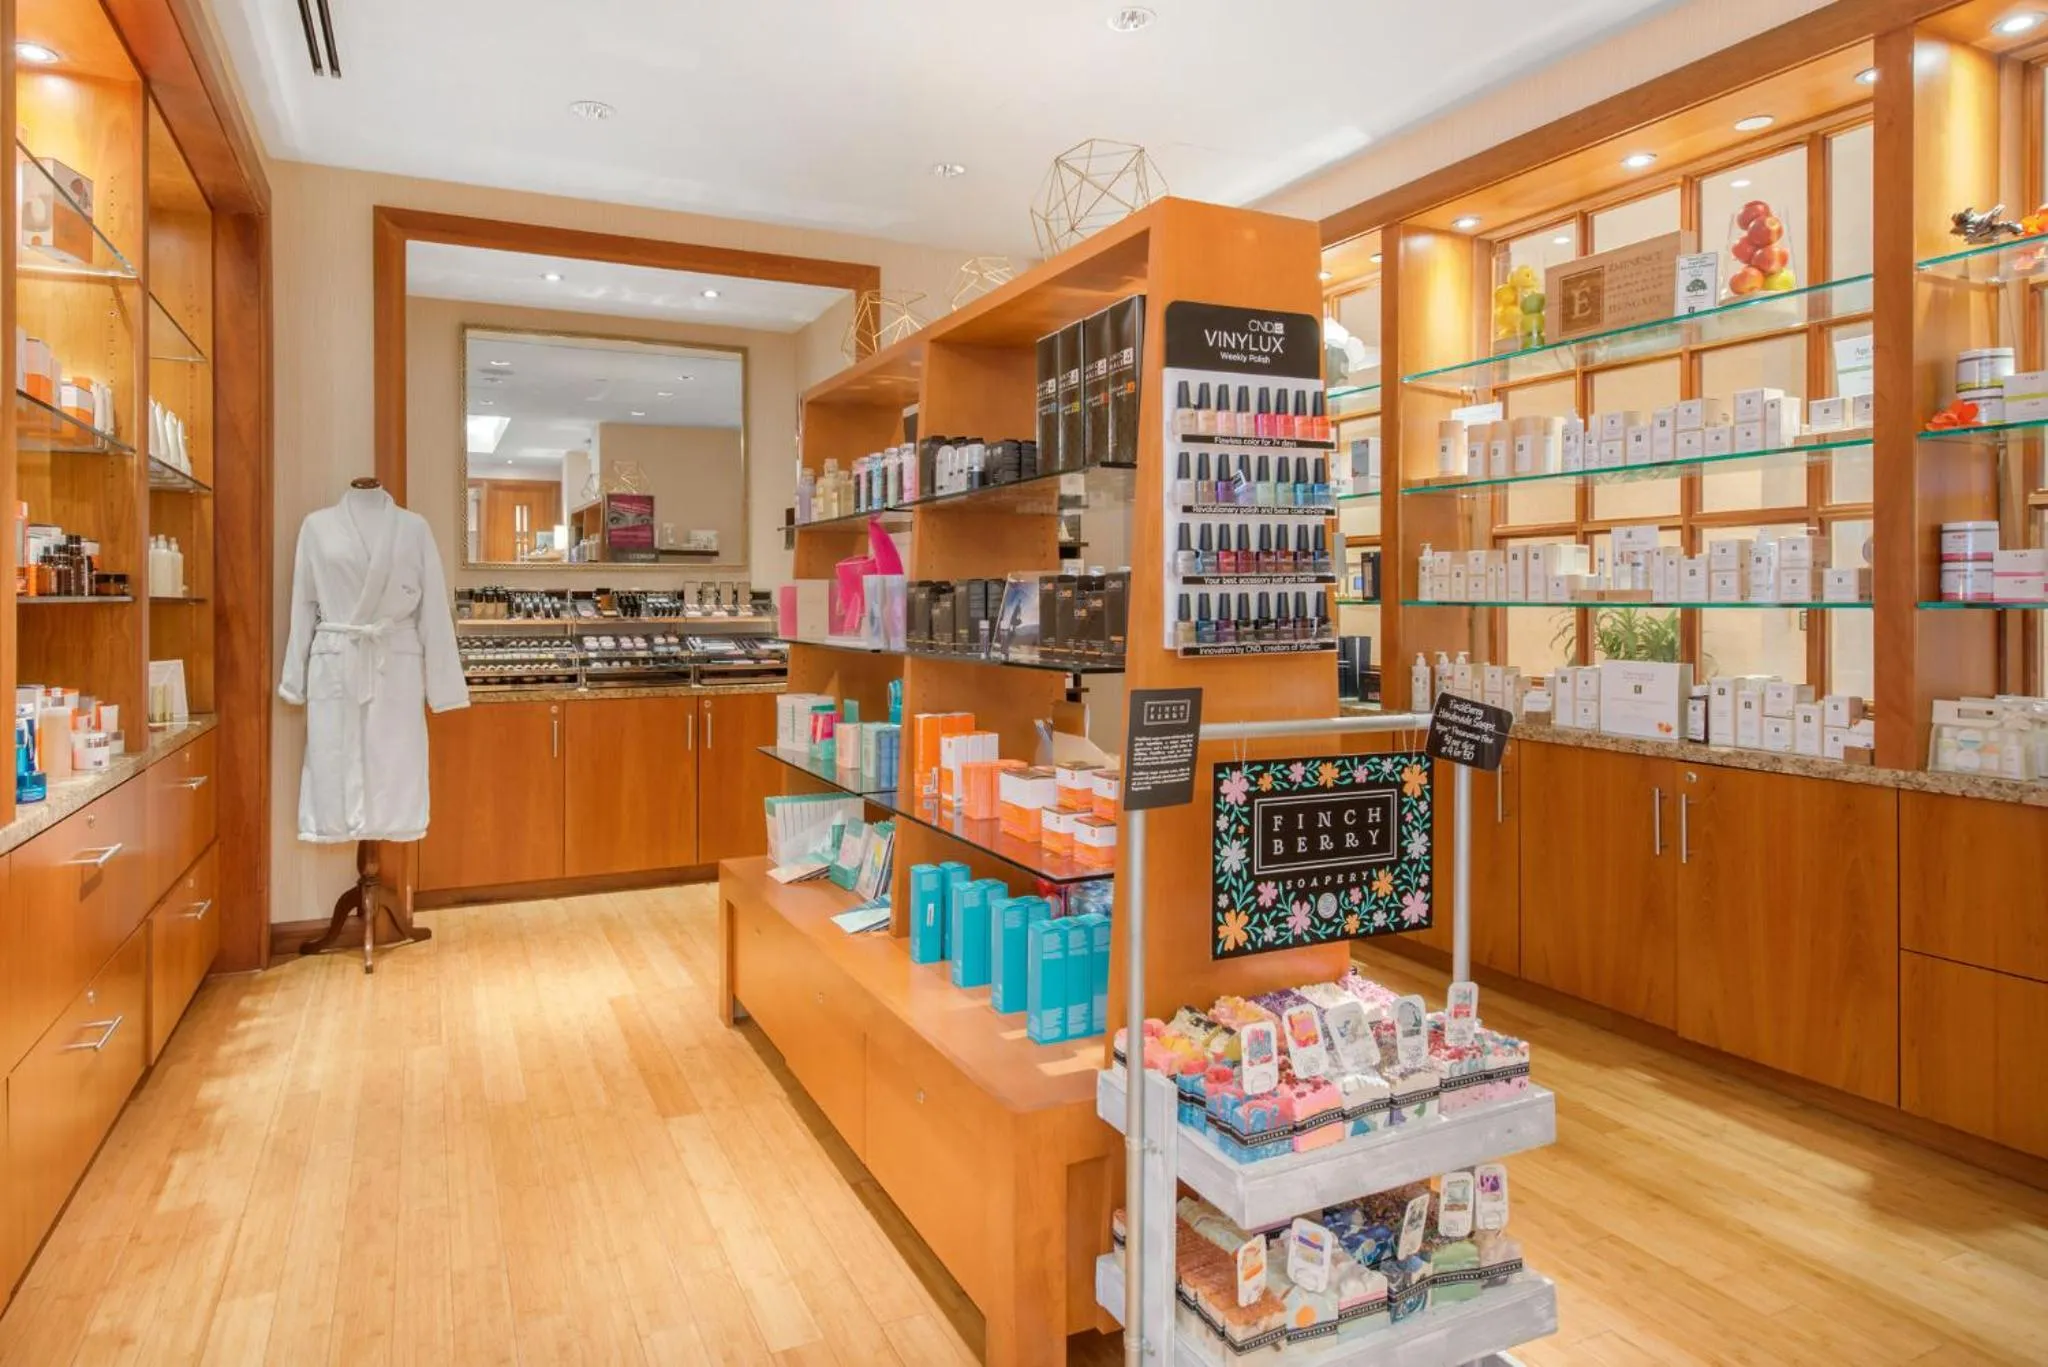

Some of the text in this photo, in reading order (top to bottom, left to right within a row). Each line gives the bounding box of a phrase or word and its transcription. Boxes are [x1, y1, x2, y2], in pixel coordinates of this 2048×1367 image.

[1204, 330, 1285, 354] VINYLUX
[1220, 352, 1271, 364] Weekly Polish
[1243, 438, 1260, 446] color
[1203, 577, 1220, 585] Your
[1199, 646, 1234, 655] Innovation
[1272, 807, 1381, 832] FINCH
[1272, 828, 1380, 855] BERRY
[1285, 871, 1369, 890] SOAPERY
